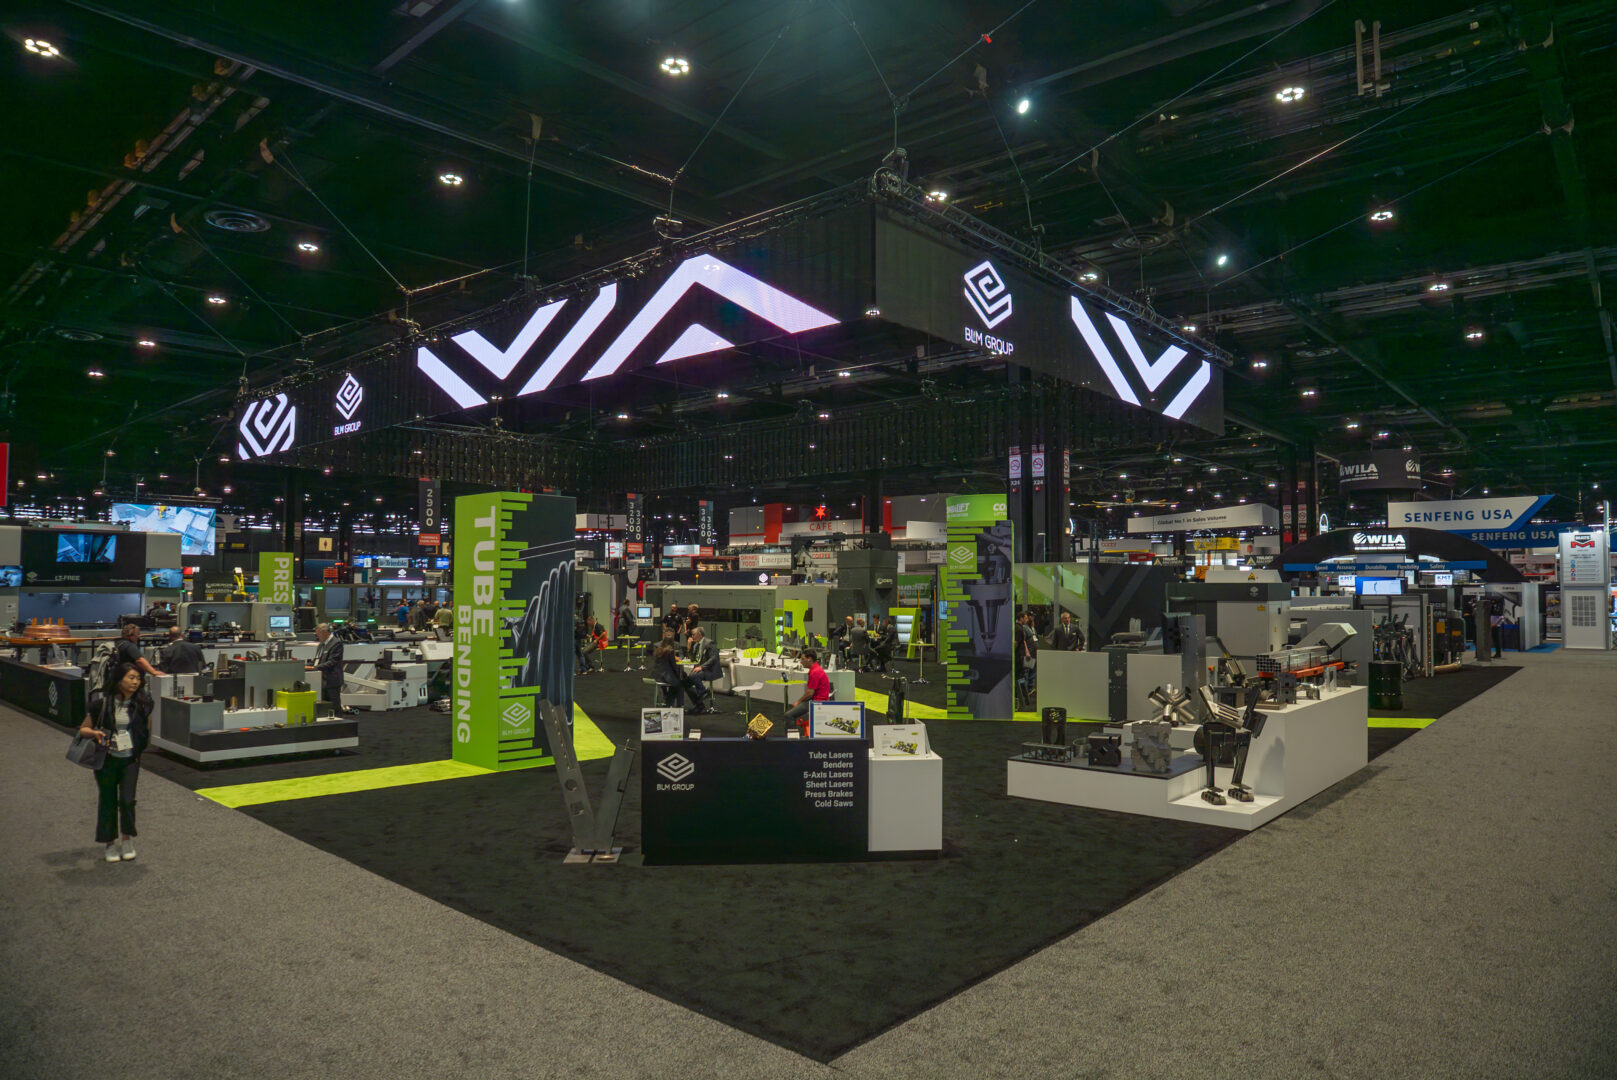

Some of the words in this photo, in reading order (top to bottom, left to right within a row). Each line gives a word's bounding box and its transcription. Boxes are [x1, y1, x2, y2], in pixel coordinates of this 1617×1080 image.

[965, 326, 983, 347] BLM
[984, 334, 1014, 356] GROUP
[334, 425, 345, 436] BLM
[344, 420, 361, 433] GROUP
[1344, 463, 1378, 475] WILA
[425, 488, 434, 527] 2900
[1404, 510, 1475, 523] SENFENG
[1481, 508, 1513, 521] USA
[809, 522, 833, 532] CAFE
[1366, 534, 1406, 545] WILA
[1471, 532, 1527, 541] SENFENG
[1531, 530, 1556, 539] USA
[472, 505, 497, 638] TUBE
[1364, 563, 1388, 571] Durability
[1396, 562, 1420, 571] Flexibility
[456, 604, 472, 744] BENDING
[808, 751, 828, 759] Tube
[828, 751, 854, 759] Lasers
[823, 760, 854, 769] Benders
[803, 770, 828, 779] 5-Axis
[828, 770, 854, 779] Lasers
[656, 783, 671, 791] BLM
[671, 783, 695, 791] GROUP
[805, 780, 828, 789] Sheet
[828, 780, 854, 788] Lasers
[804, 790, 827, 798] Press
[827, 789, 854, 798] Brakes
[814, 799, 832, 808] Cold
[832, 799, 854, 807] Saws
